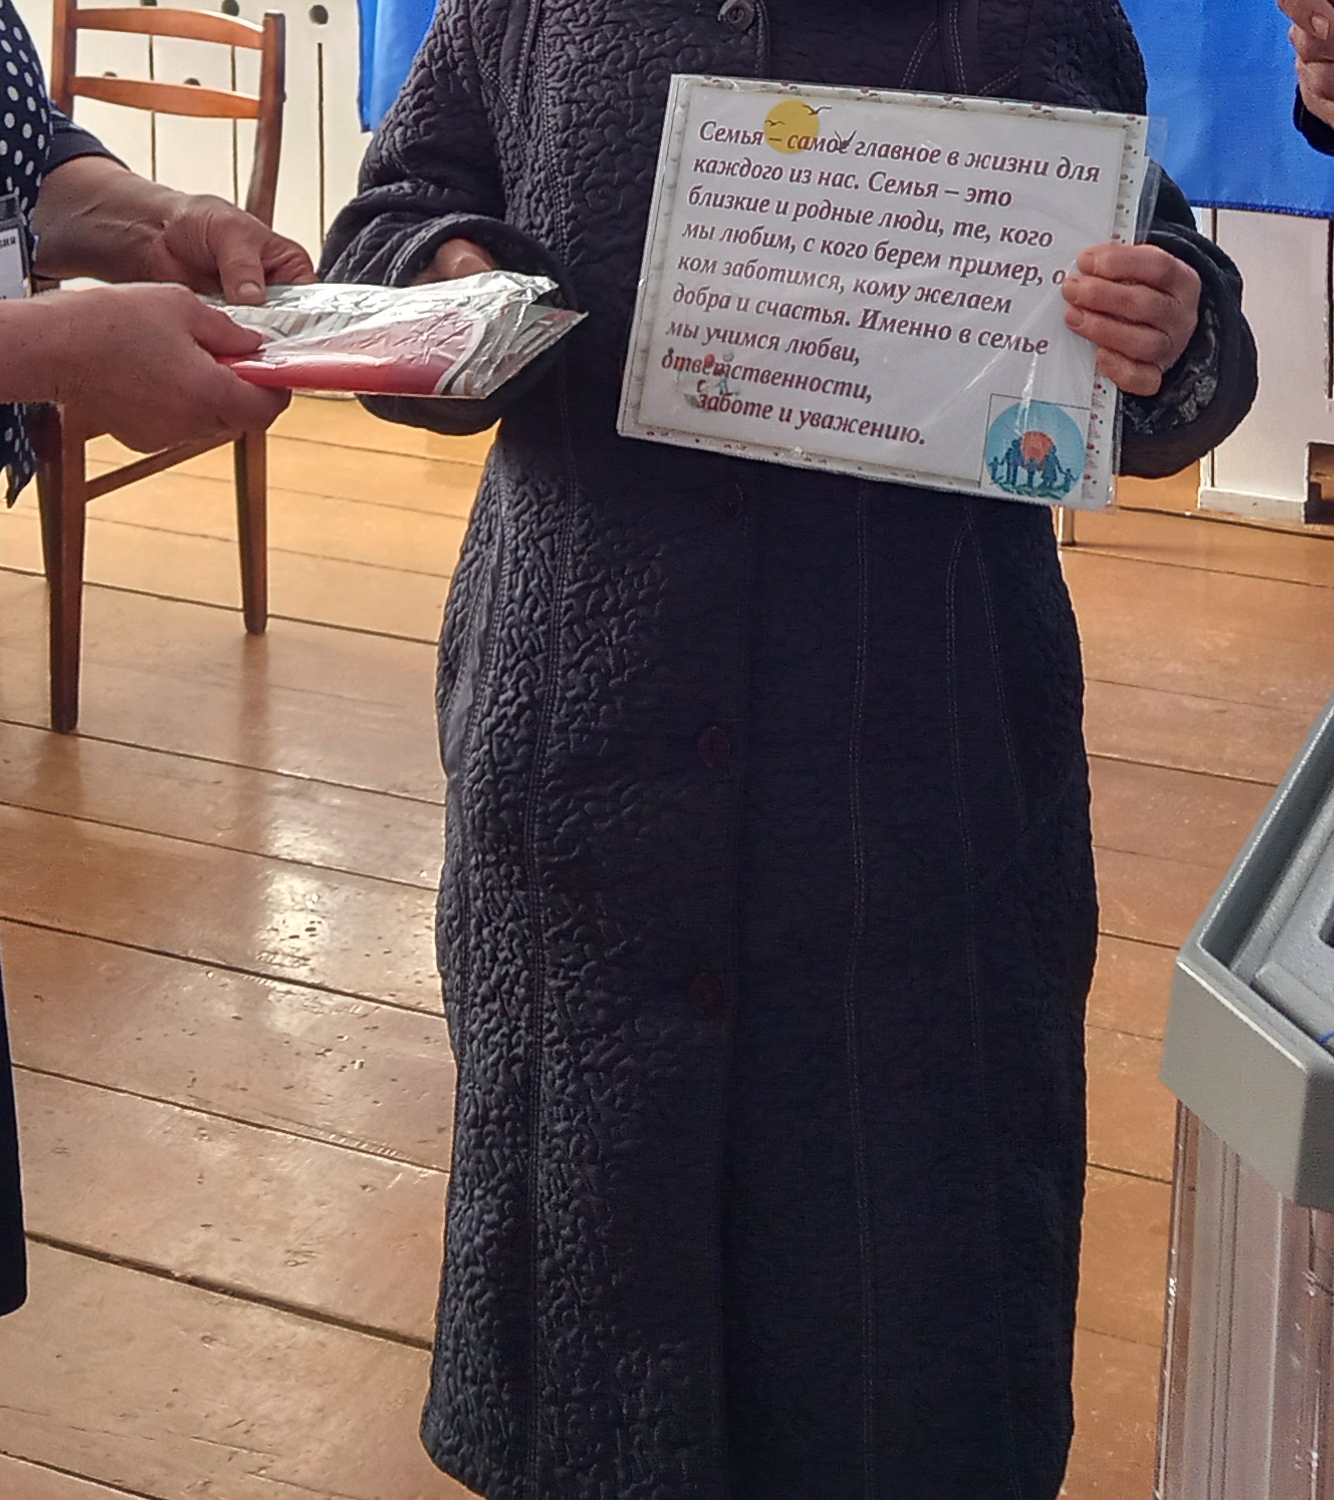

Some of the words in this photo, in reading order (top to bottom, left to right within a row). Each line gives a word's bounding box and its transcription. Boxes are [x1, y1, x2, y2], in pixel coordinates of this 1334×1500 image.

[699, 120, 764, 146] Семья
[854, 140, 941, 165] главное
[947, 150, 960, 166] в
[964, 152, 1049, 176] жизни
[1055, 157, 1100, 182] для
[693, 156, 783, 181] каждого
[789, 167, 812, 184] из
[817, 172, 860, 190] нас.
[868, 170, 938, 199] Семья
[964, 186, 1012, 207] это
[688, 184, 770, 214] близкие
[775, 200, 789, 216] и
[791, 199, 874, 226] родные
[877, 209, 944, 236] люди,
[952, 220, 991, 243] те,
[999, 227, 1053, 248] кого
[682, 222, 715, 240] мы
[719, 226, 796, 254] любим,
[803, 236, 815, 252] с
[820, 240, 868, 259] кого
[874, 240, 942, 269] берем
[947, 254, 1043, 286] пример,
[677, 256, 718, 274] ком
[722, 258, 845, 294] заботимся,
[852, 277, 911, 304] кому
[914, 285, 1012, 314] желаем
[666, 322, 699, 339] мы
[702, 326, 780, 351] учимся
[785, 337, 860, 366] любви,
[673, 283, 731, 312] добра
[736, 297, 750, 313] и
[755, 299, 851, 327] счастья.
[858, 308, 952, 341] Именно
[959, 328, 971, 344] в
[978, 330, 1049, 355] семье
[697, 392, 773, 419] заботе
[779, 407, 792, 423] и
[795, 408, 925, 445] уважению.
